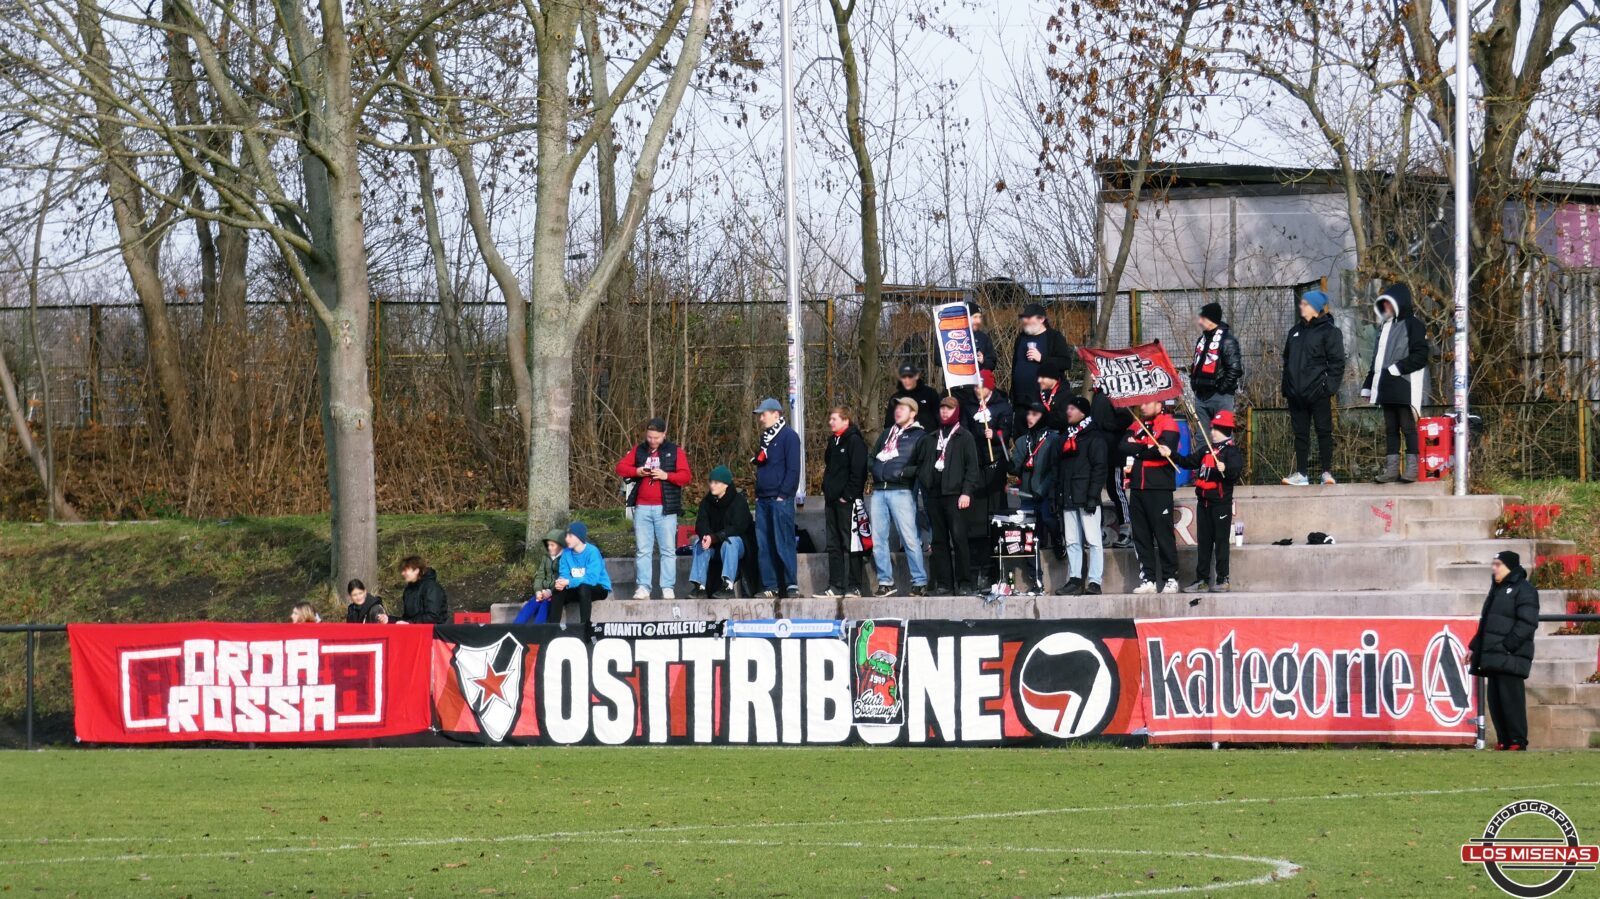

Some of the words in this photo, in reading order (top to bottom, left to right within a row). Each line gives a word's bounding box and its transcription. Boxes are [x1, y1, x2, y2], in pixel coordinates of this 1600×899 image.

[604, 623, 642, 637] AVANTI
[656, 621, 706, 636] ATHLETIC
[183, 638, 320, 687] ORDA
[1146, 630, 1414, 720] kategorie
[168, 683, 336, 733] ROSSA
[861, 689, 883, 706] Gute
